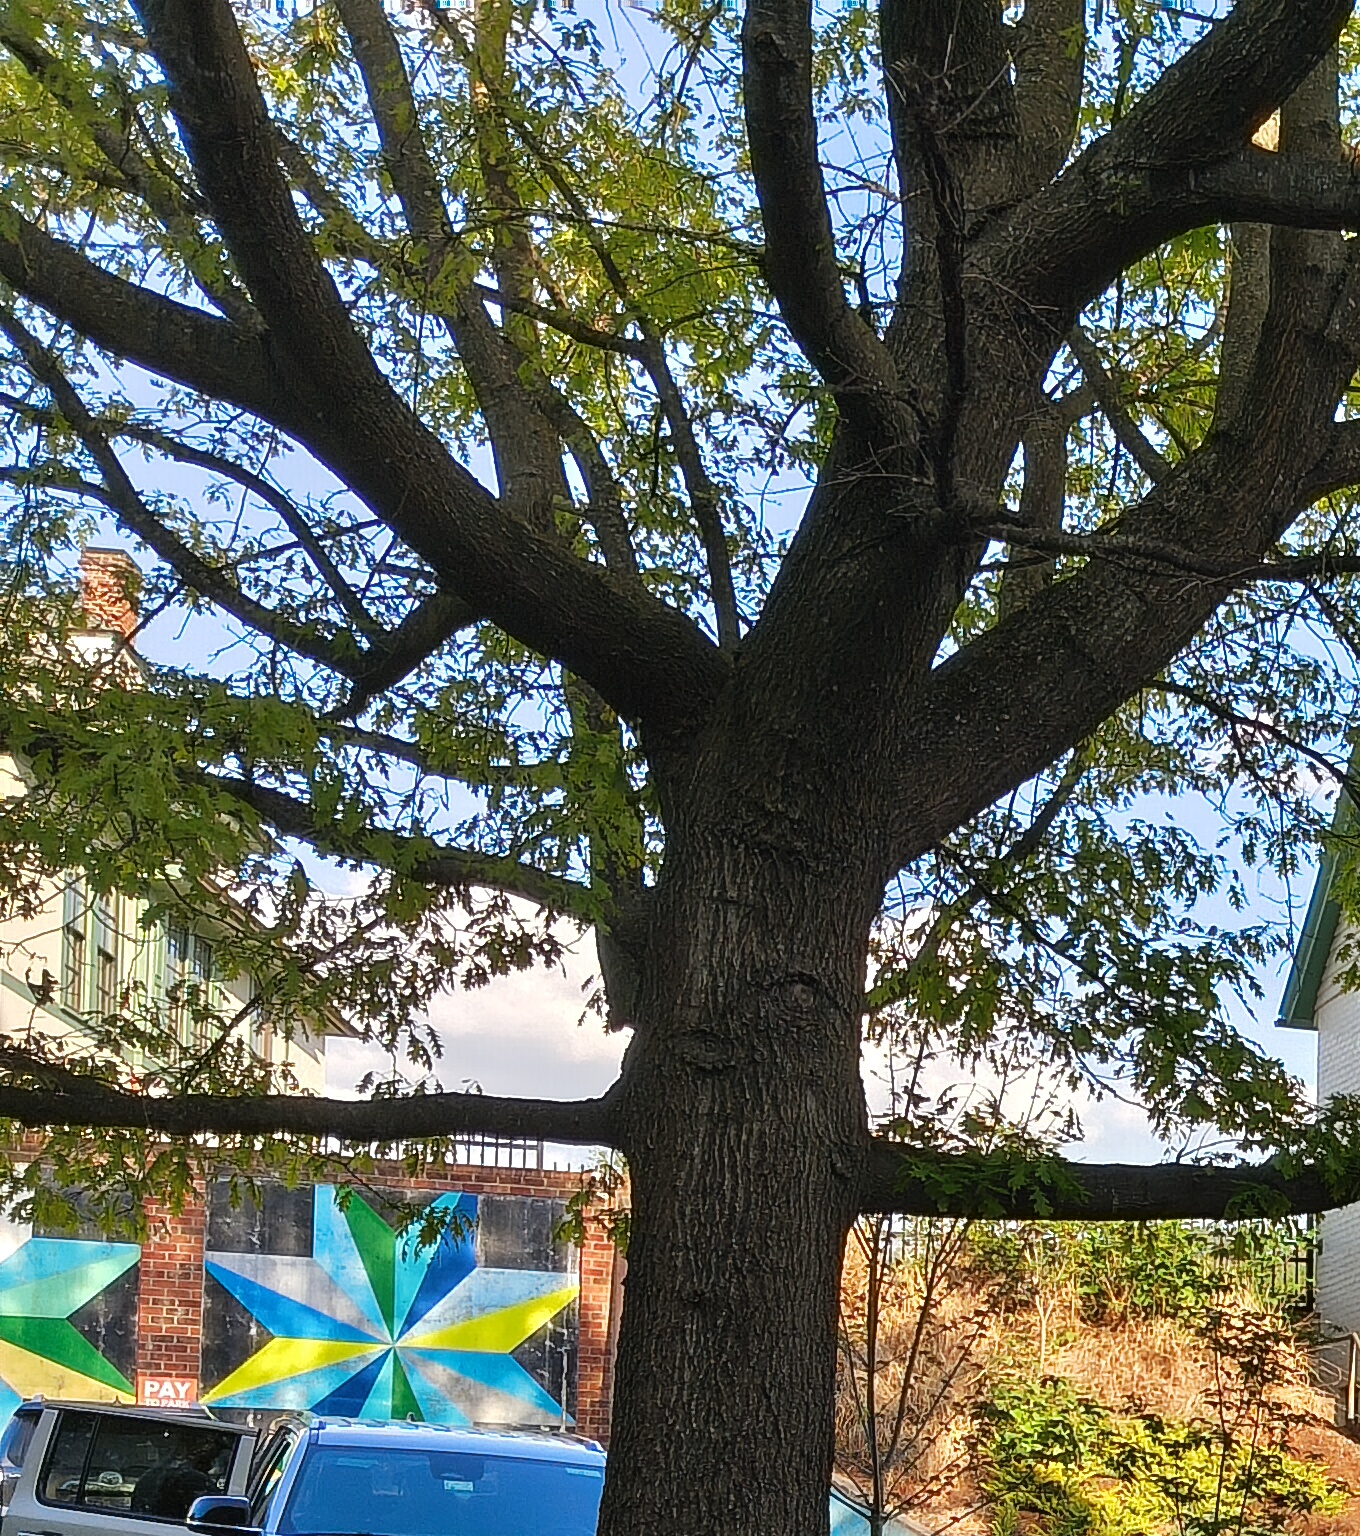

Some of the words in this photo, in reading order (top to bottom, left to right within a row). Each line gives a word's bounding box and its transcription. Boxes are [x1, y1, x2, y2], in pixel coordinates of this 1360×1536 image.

[144, 1380, 192, 1399] PAY
[145, 1398, 160, 1406] TO
[161, 1399, 190, 1408] PARK
